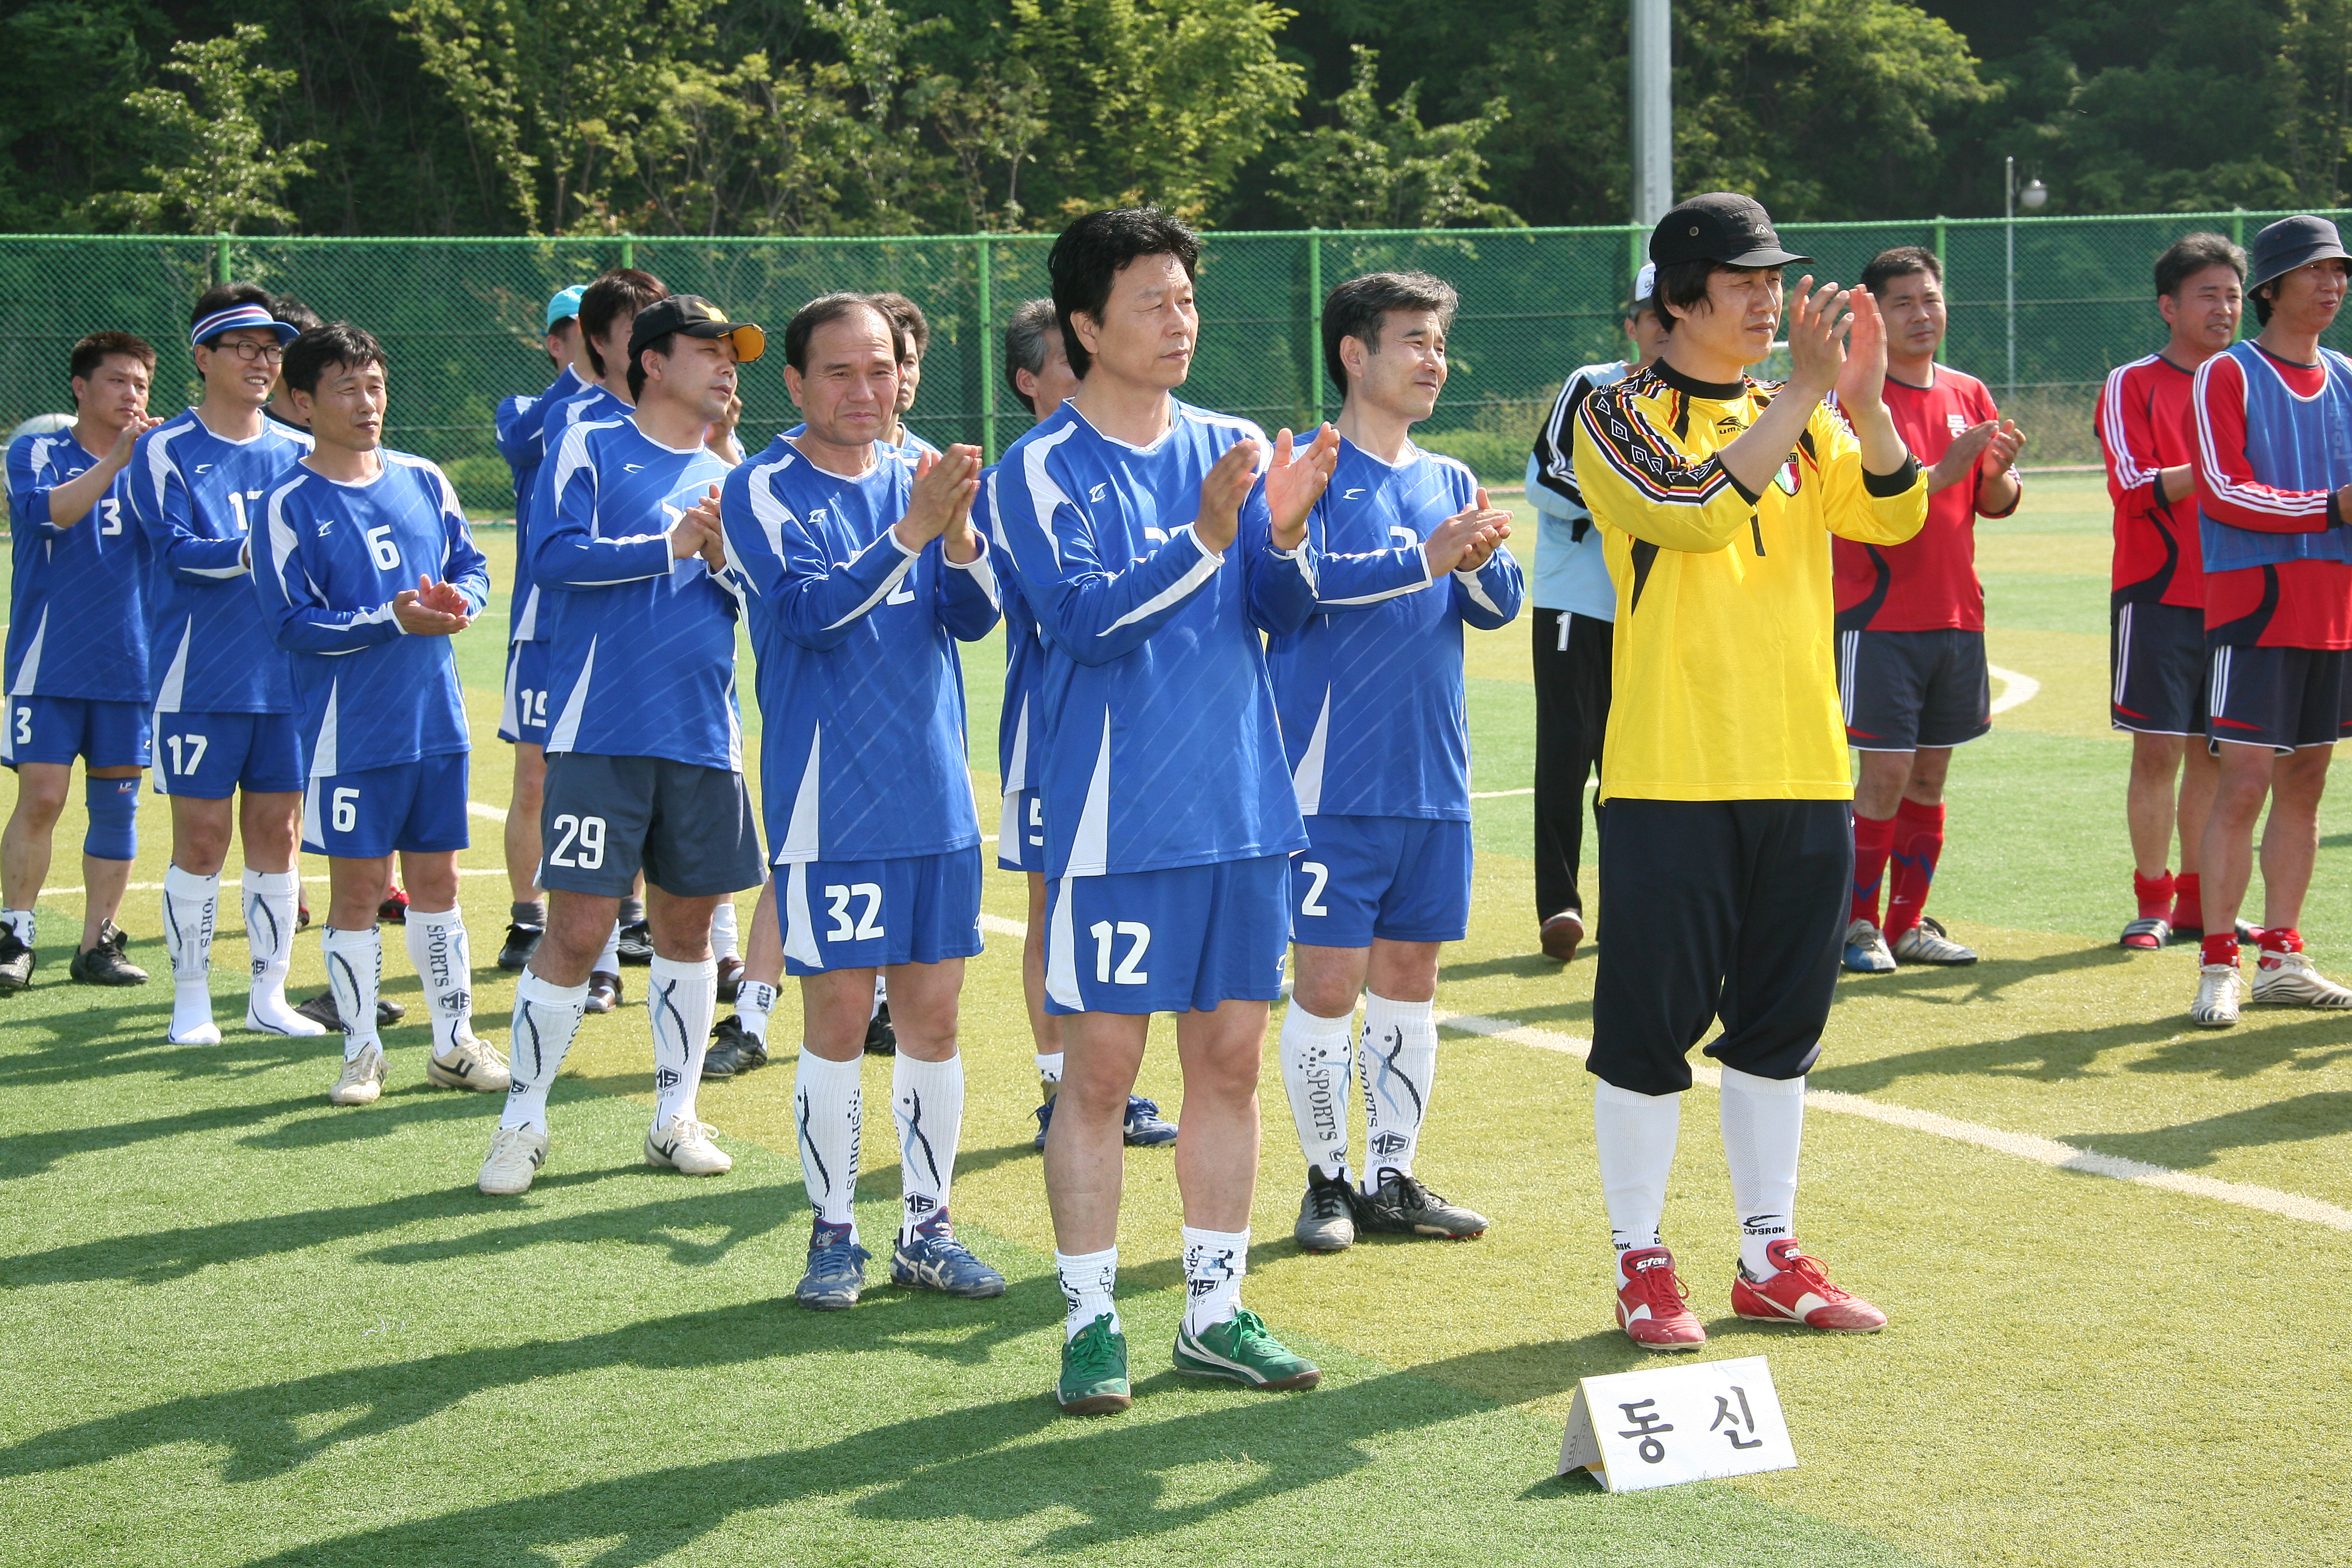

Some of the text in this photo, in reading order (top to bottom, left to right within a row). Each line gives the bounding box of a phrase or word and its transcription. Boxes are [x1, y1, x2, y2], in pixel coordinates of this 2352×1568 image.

[101, 498, 122, 535] 3
[367, 524, 400, 571] 6
[1557, 612, 1572, 650] 1
[16, 707, 32, 744] 3
[167, 734, 208, 775] 17
[332, 787, 359, 832] 6
[550, 814, 606, 870] 29
[825, 882, 885, 942] 32
[1301, 862, 1328, 916] 2
[427, 925, 449, 987] SPORTS
[1089, 919, 1152, 984] 12
[1304, 1068, 1338, 1141] SPORTS
[1358, 1051, 1378, 1128] SPORTS
[1744, 1226, 1786, 1235] CAPSROK
